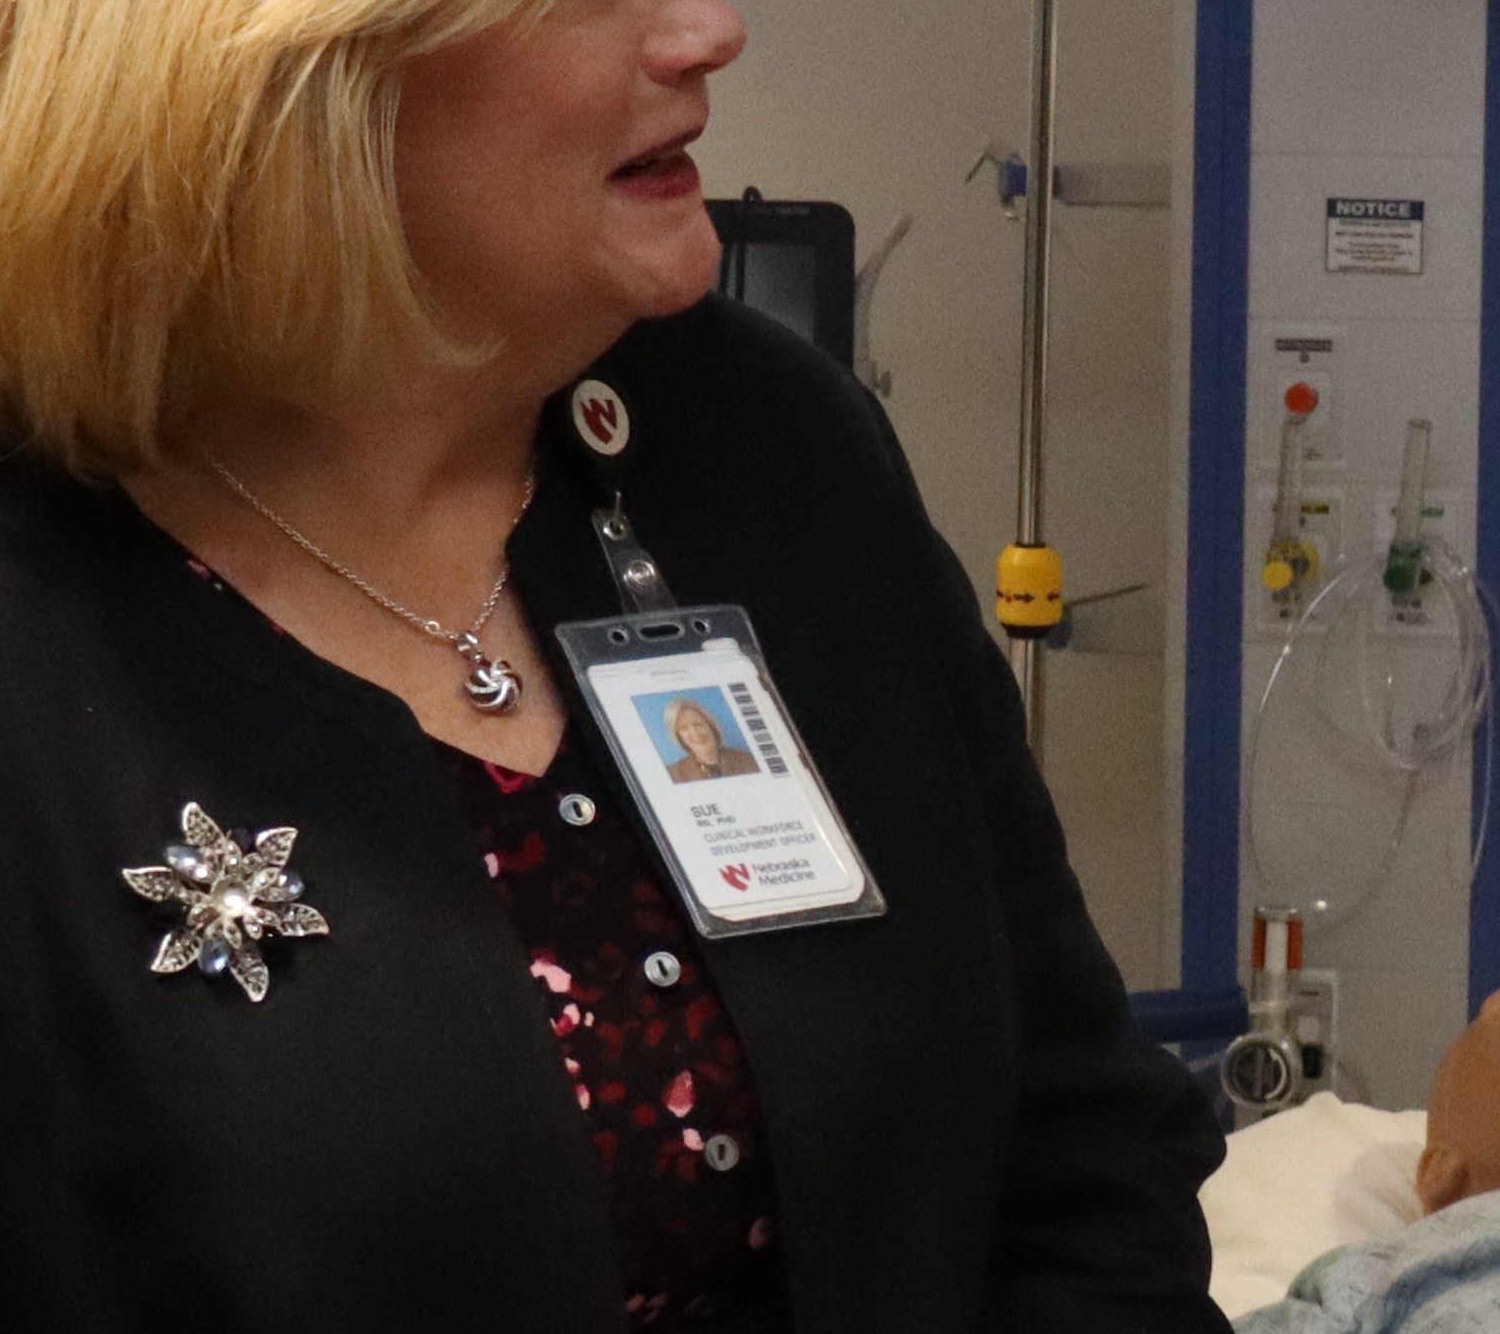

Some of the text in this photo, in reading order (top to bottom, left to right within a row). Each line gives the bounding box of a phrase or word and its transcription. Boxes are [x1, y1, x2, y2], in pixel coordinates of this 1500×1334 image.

[1335, 201, 1412, 217] NOTICE
[690, 803, 722, 817] SUE
[704, 820, 805, 843] CLINICAL WORKFORCE
[709, 833, 818, 856] DEVELOPMENT OFFICER
[751, 858, 811, 874] Nebraska
[758, 870, 817, 887] Medicine
